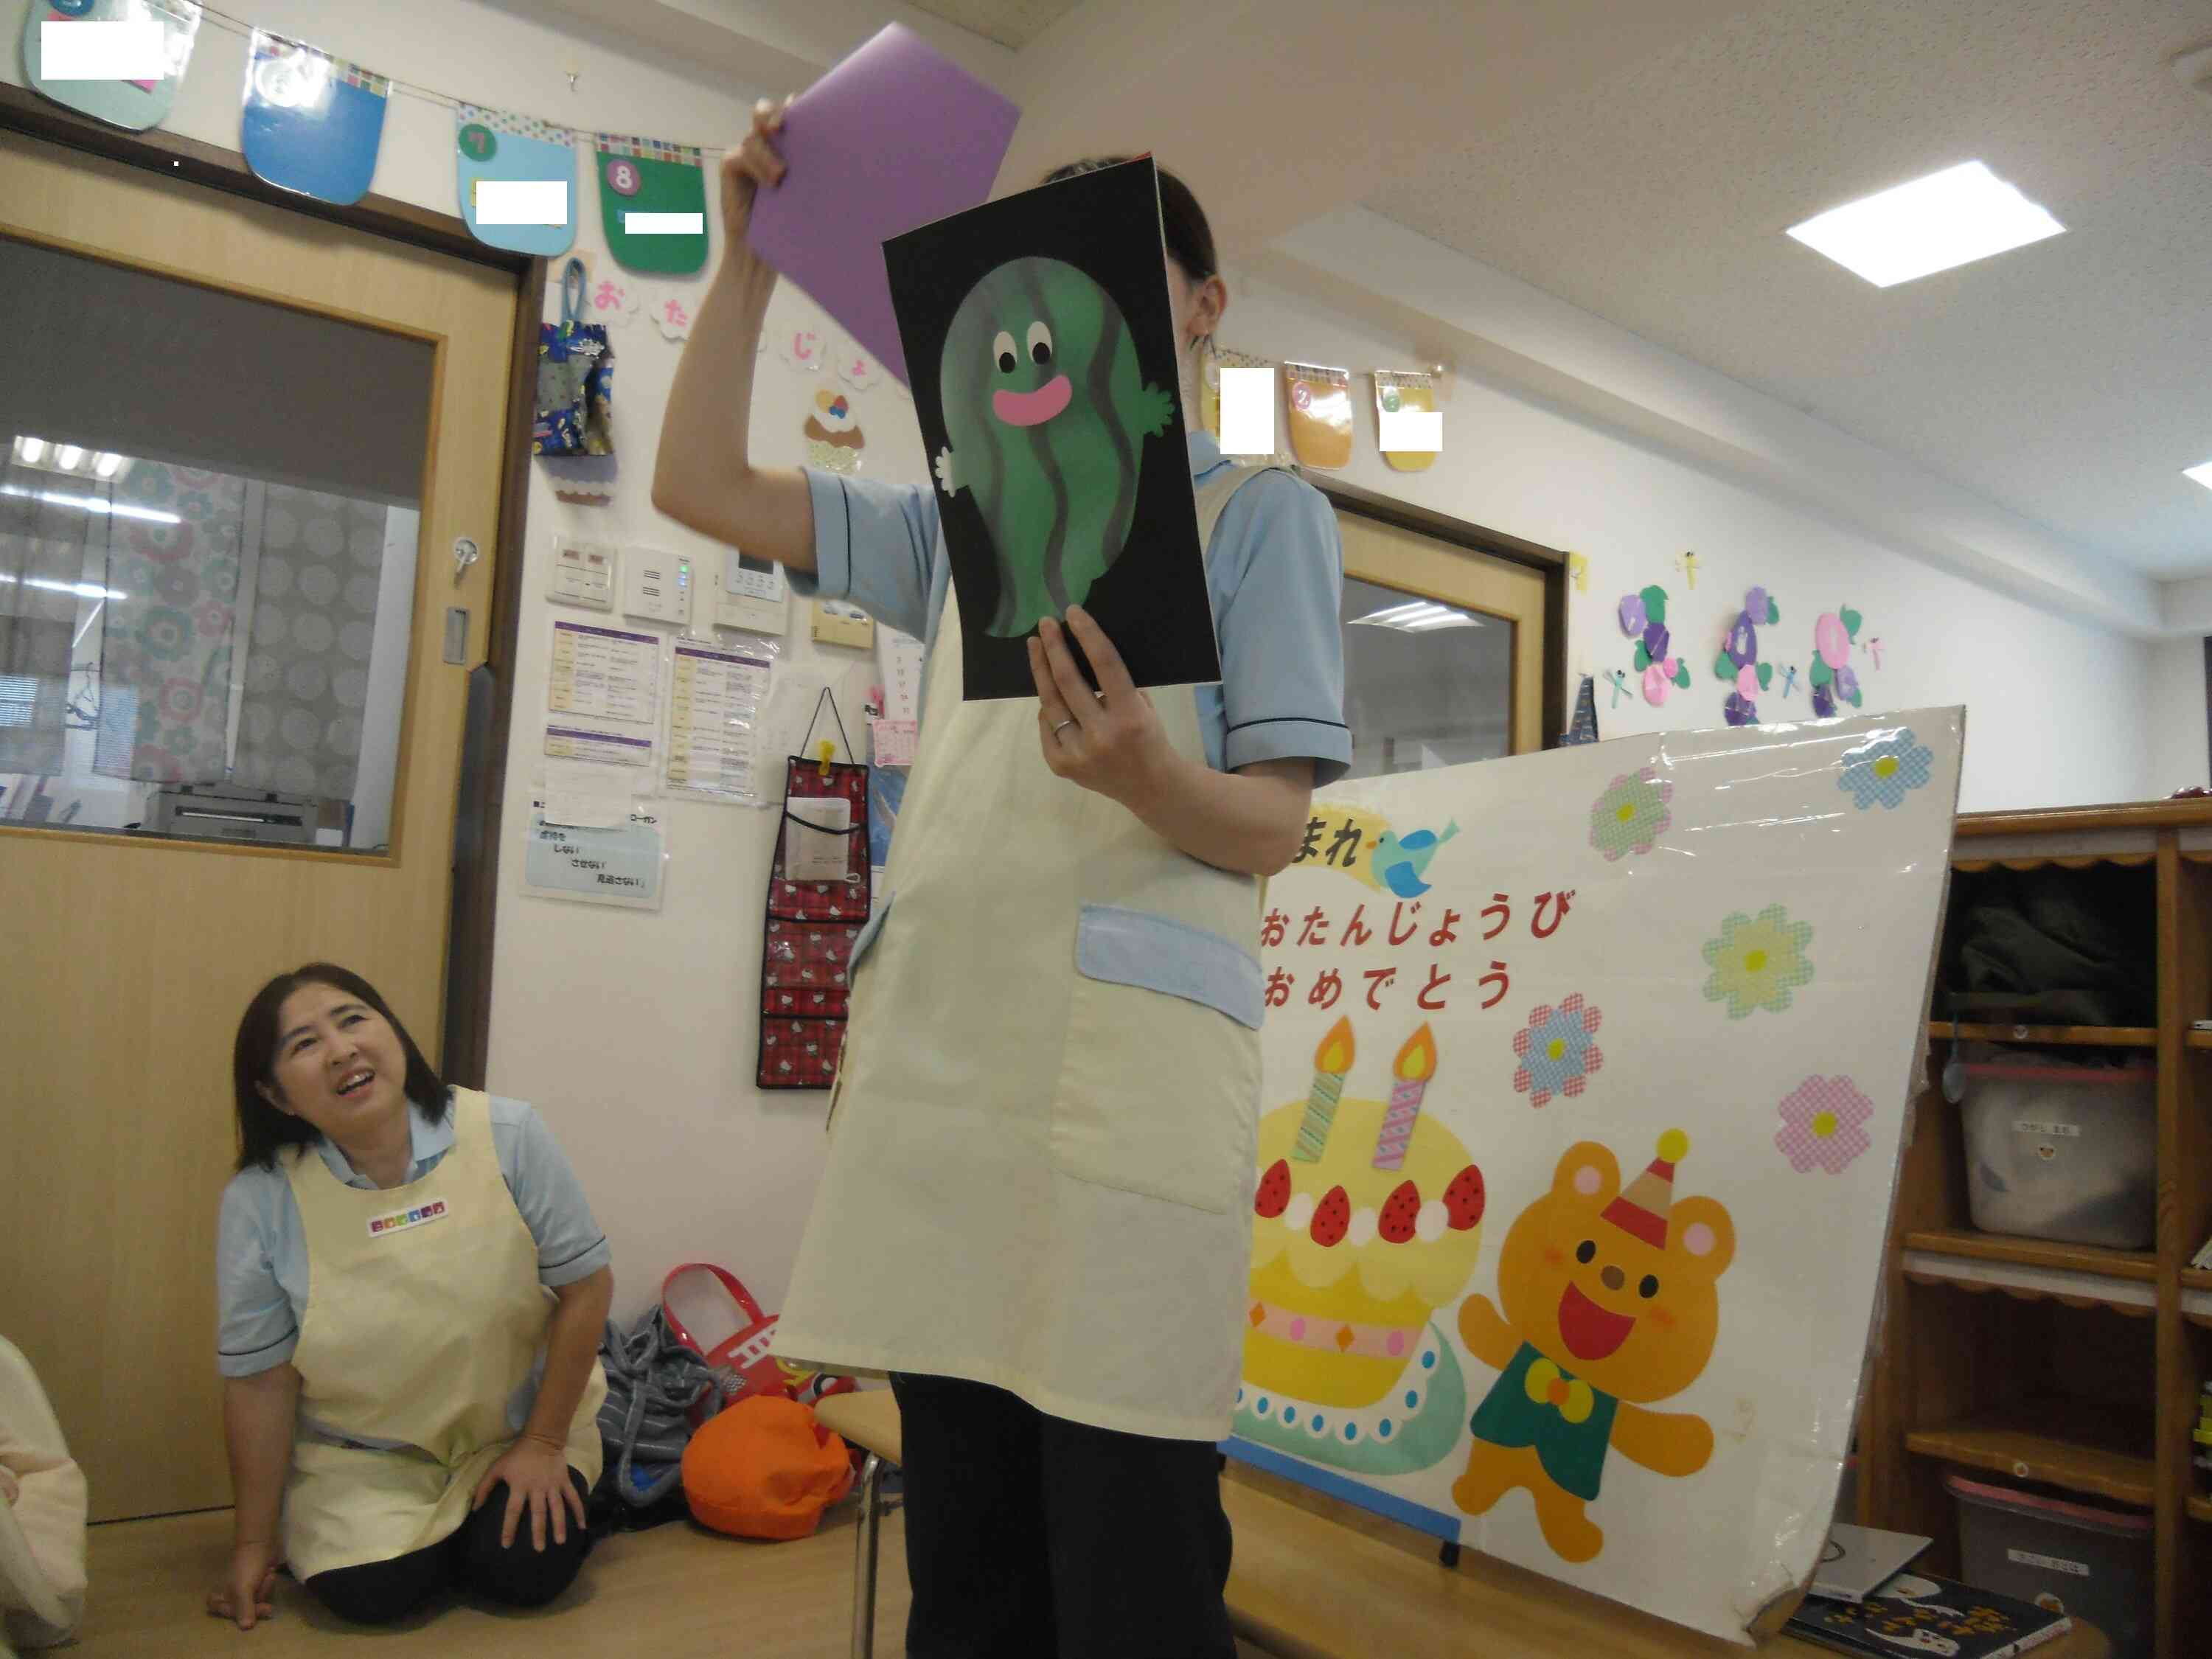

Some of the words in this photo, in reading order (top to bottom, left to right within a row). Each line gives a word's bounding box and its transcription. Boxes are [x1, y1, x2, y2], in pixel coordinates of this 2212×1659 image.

[467, 131, 486, 154] 7
[616, 165, 633, 189] 8
[554, 844, 580, 855] しない
[571, 858, 607, 870] させない
[1260, 888, 1576, 947] おたんじょうび
[1264, 960, 1510, 1011] おめでとう
